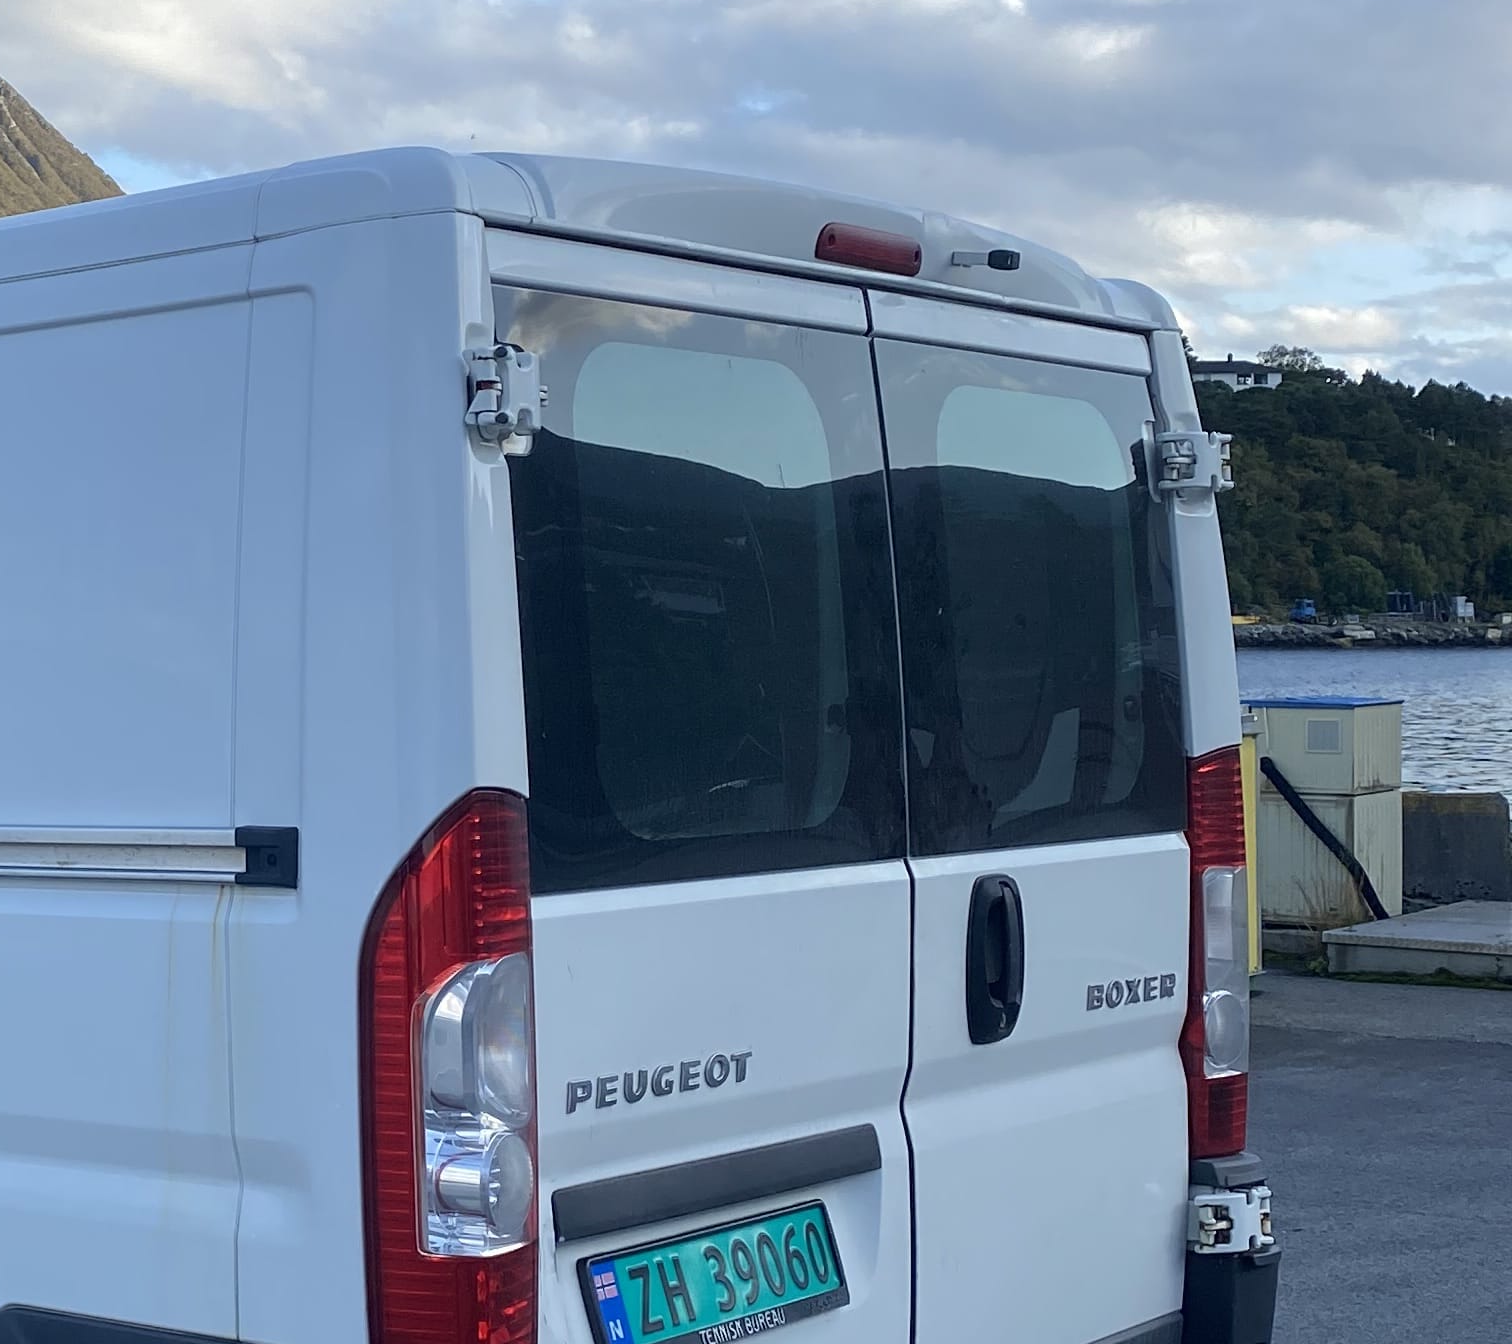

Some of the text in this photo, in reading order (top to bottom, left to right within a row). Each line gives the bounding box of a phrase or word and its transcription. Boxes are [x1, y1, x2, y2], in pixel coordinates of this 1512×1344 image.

[1086, 972, 1177, 1011] BOXER
[565, 1050, 753, 1115] PEUGEOT
[628, 1217, 832, 1336] ZH 39060
[609, 1318, 625, 1341] N
[744, 1306, 787, 1335] BUREAU
